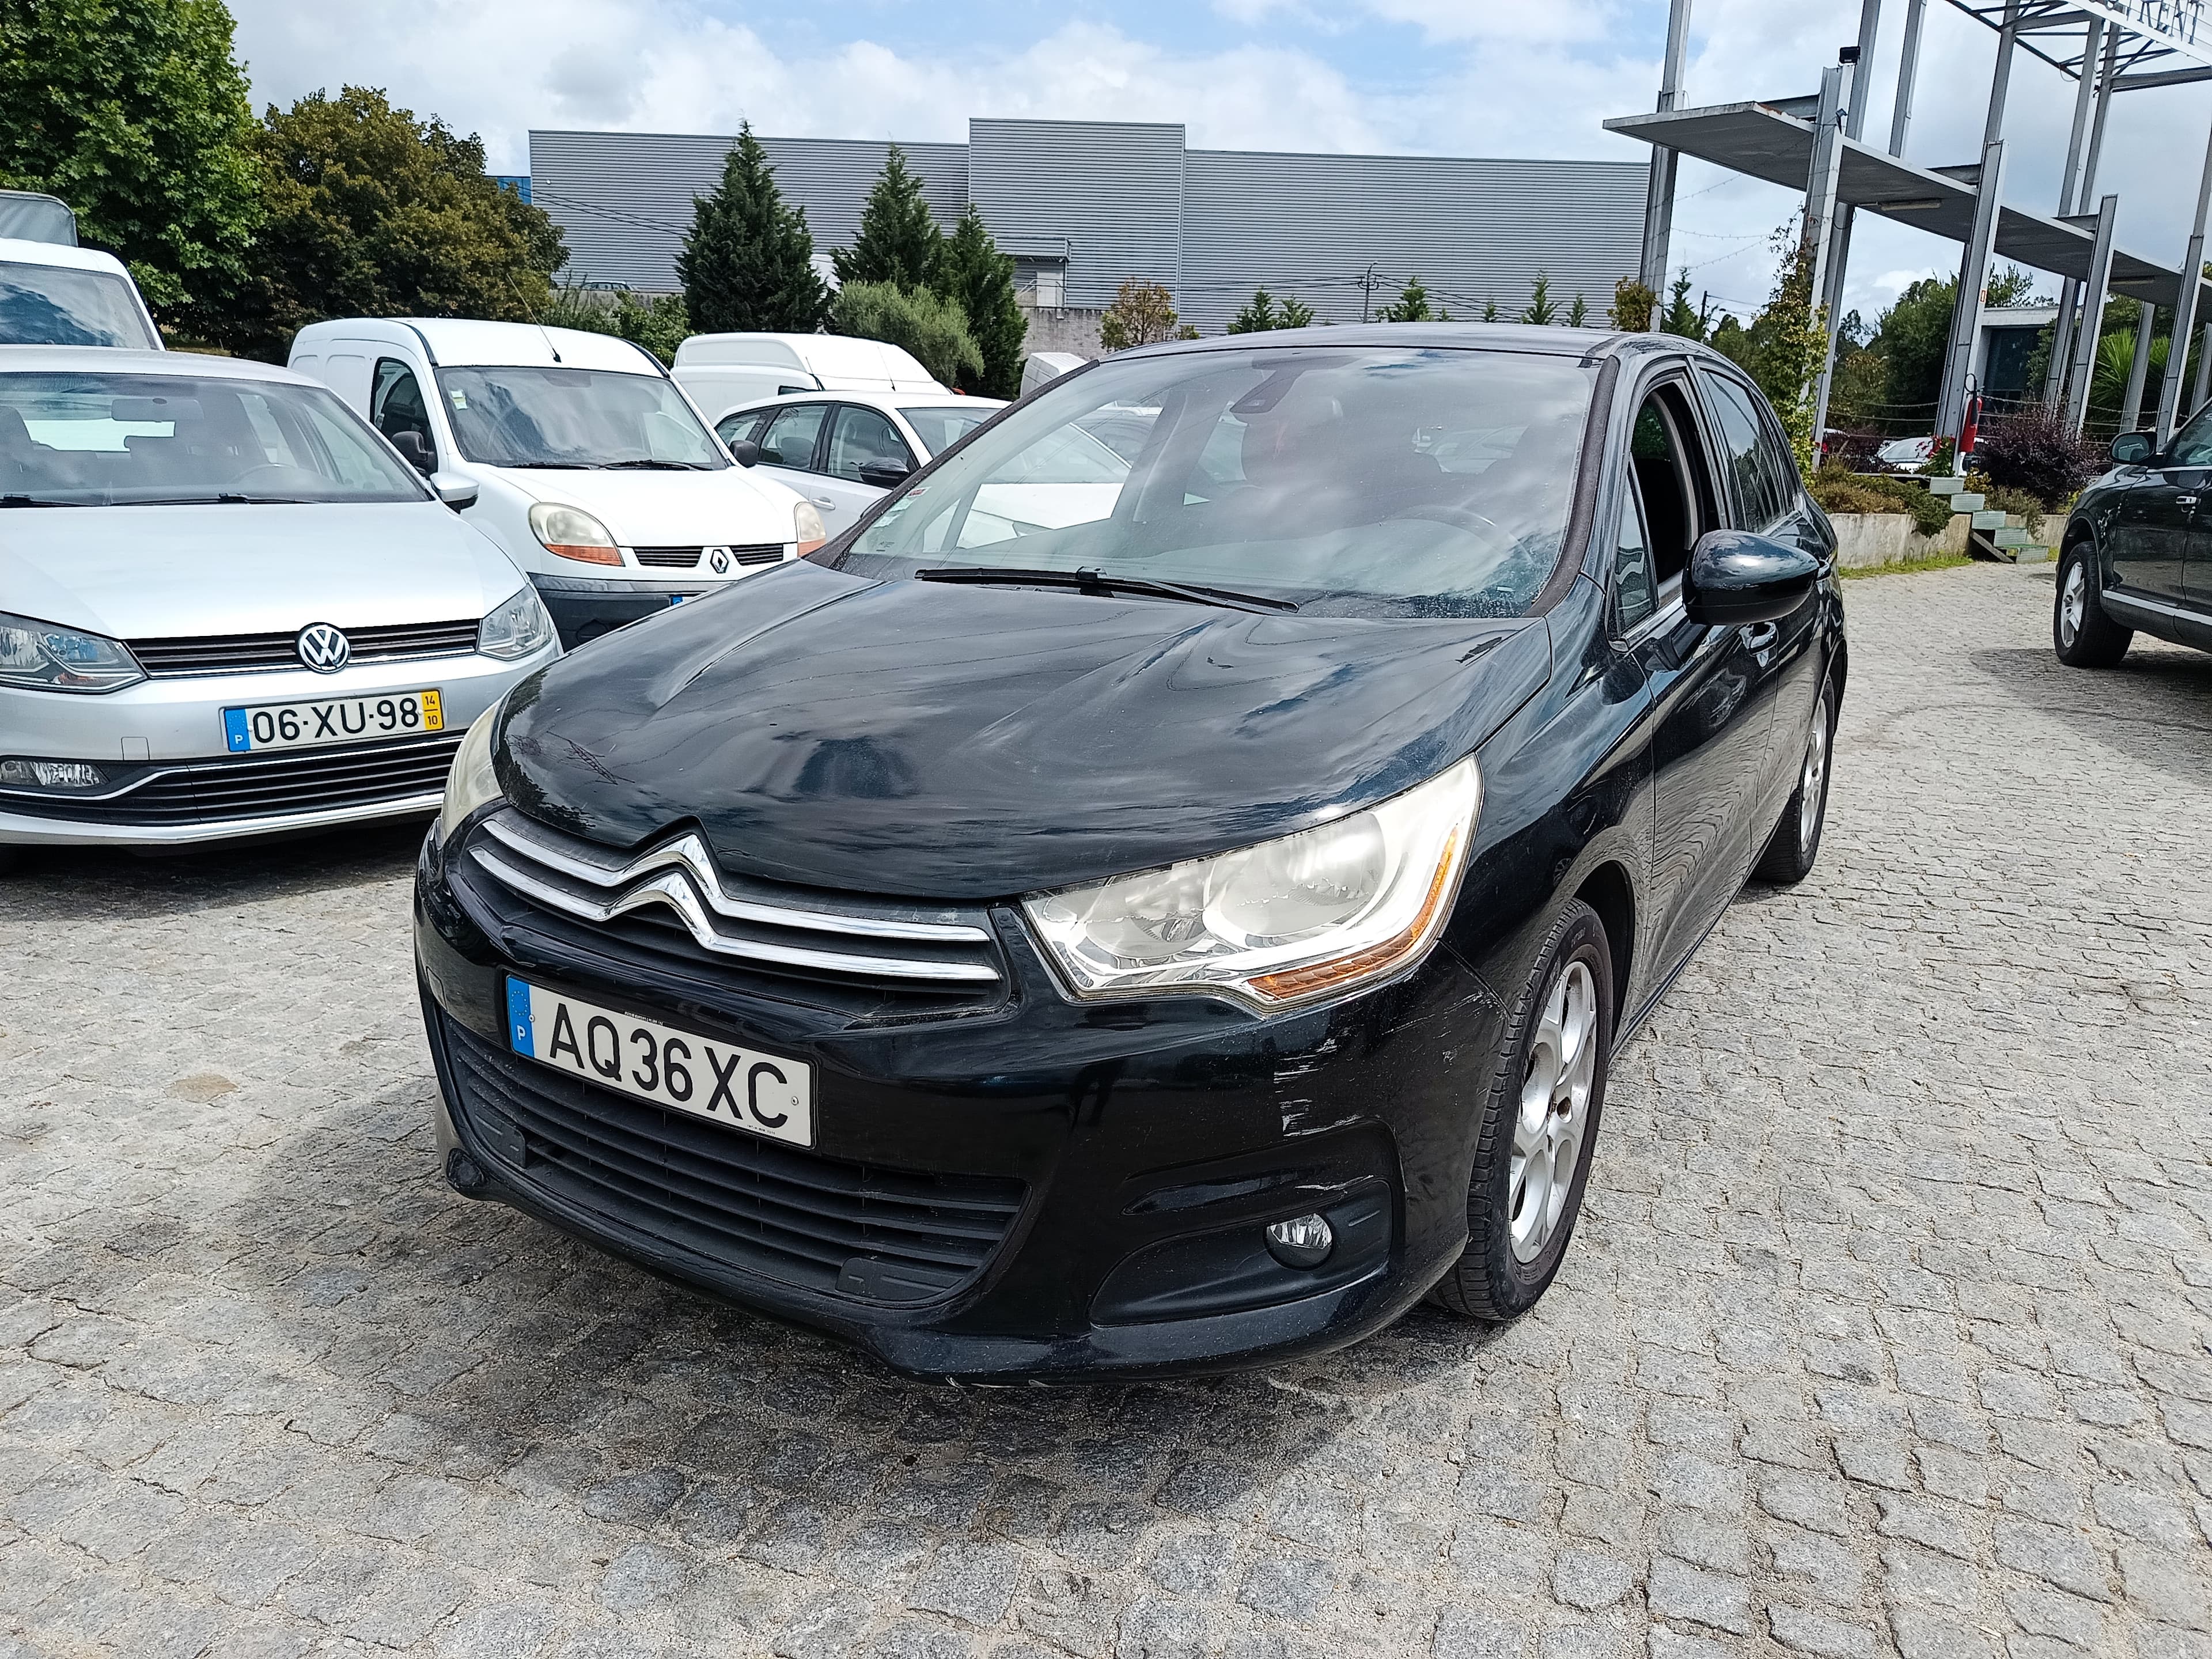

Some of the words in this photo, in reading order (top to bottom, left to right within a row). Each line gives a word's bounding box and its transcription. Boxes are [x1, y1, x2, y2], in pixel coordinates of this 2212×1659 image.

[425, 695, 435, 706] 14
[427, 715, 438, 726] 10
[234, 734, 243, 744] P
[517, 1025, 525, 1040] P
